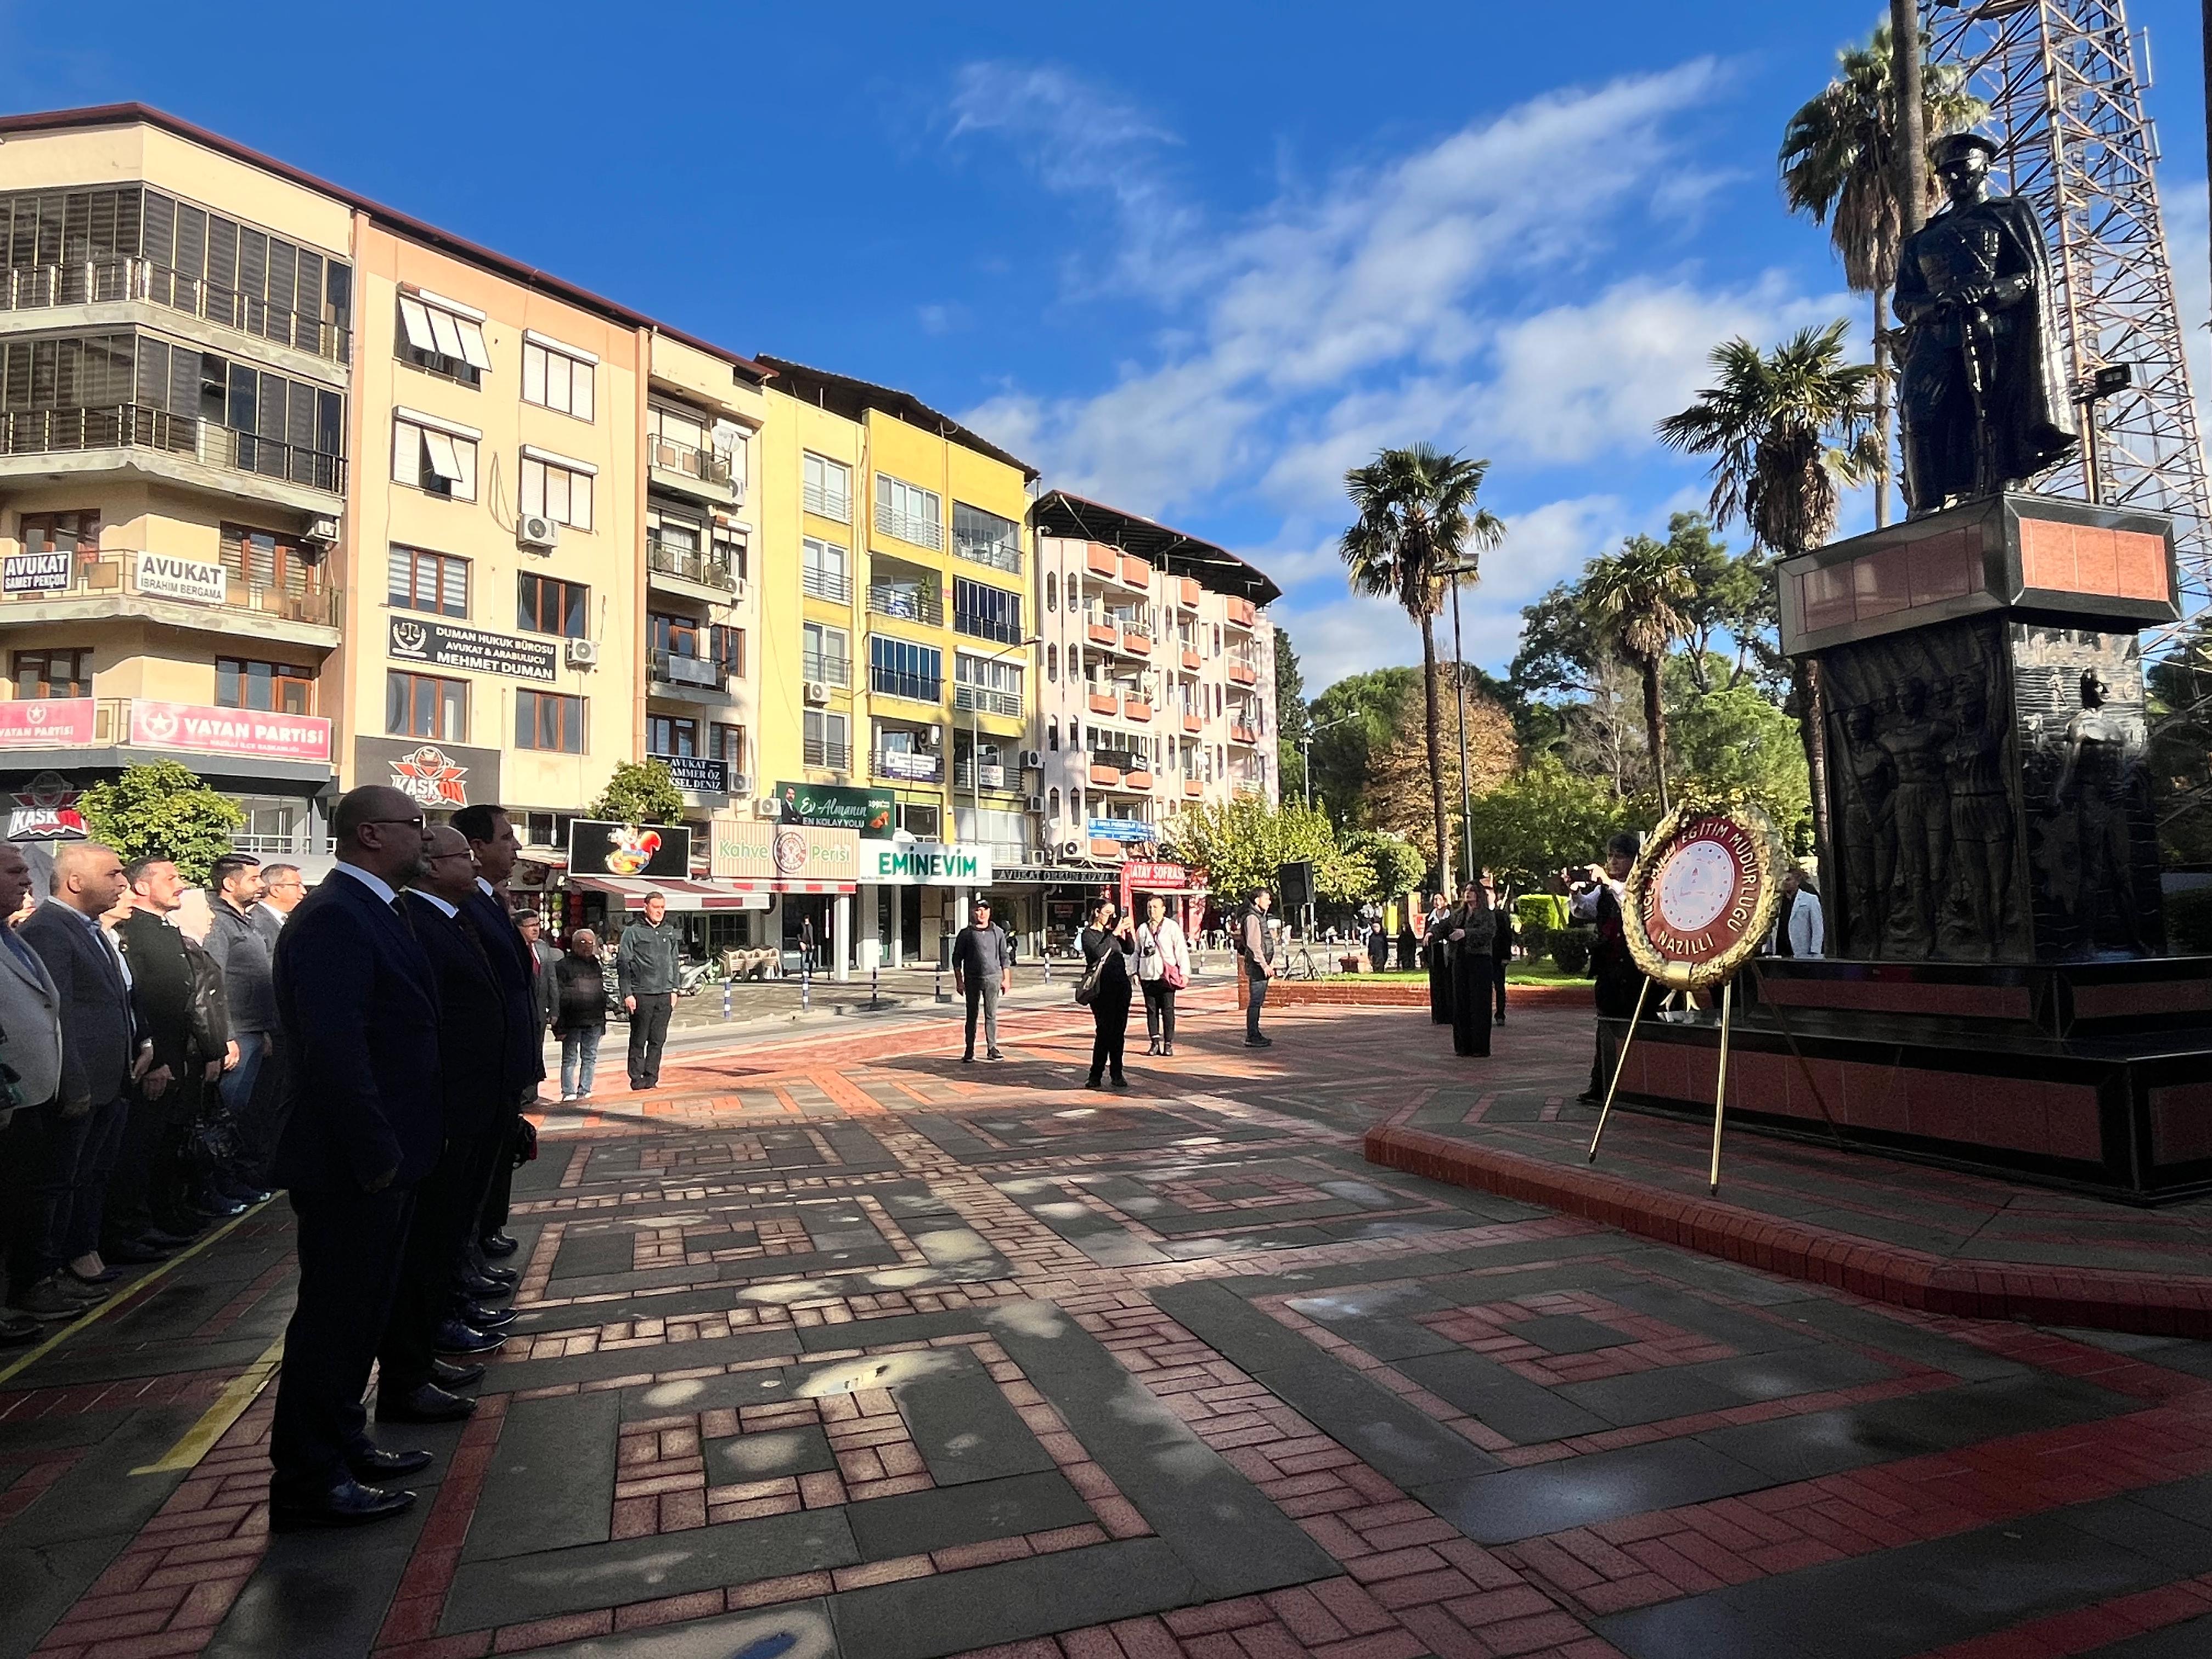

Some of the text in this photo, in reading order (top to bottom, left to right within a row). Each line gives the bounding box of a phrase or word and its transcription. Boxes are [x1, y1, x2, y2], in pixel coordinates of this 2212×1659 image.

[5, 554, 67, 576] AVUKAT
[142, 556, 222, 585] AVUKAT
[180, 584, 222, 600] BERGAMA
[436, 627, 554, 656] DUMAN HUKUK BÜROSU
[445, 641, 546, 665] AVUKAT & ARABULUCU
[436, 651, 553, 680] MEHMET DUMAN
[0, 727, 32, 737] VATAN
[184, 718, 324, 744] VATAN PARTİSİ
[670, 758, 707, 769] AVUKAT
[670, 768, 720, 780] AMMER ÖZ
[394, 777, 465, 805] KASKÖN
[668, 777, 721, 791] KSEL DENİZ
[799, 797, 816, 815] Ev
[803, 817, 865, 828] EN KOLAY YOLU
[719, 840, 769, 859] Kahve
[811, 844, 850, 862] Perisi
[879, 845, 977, 877] EMİNEVİM
